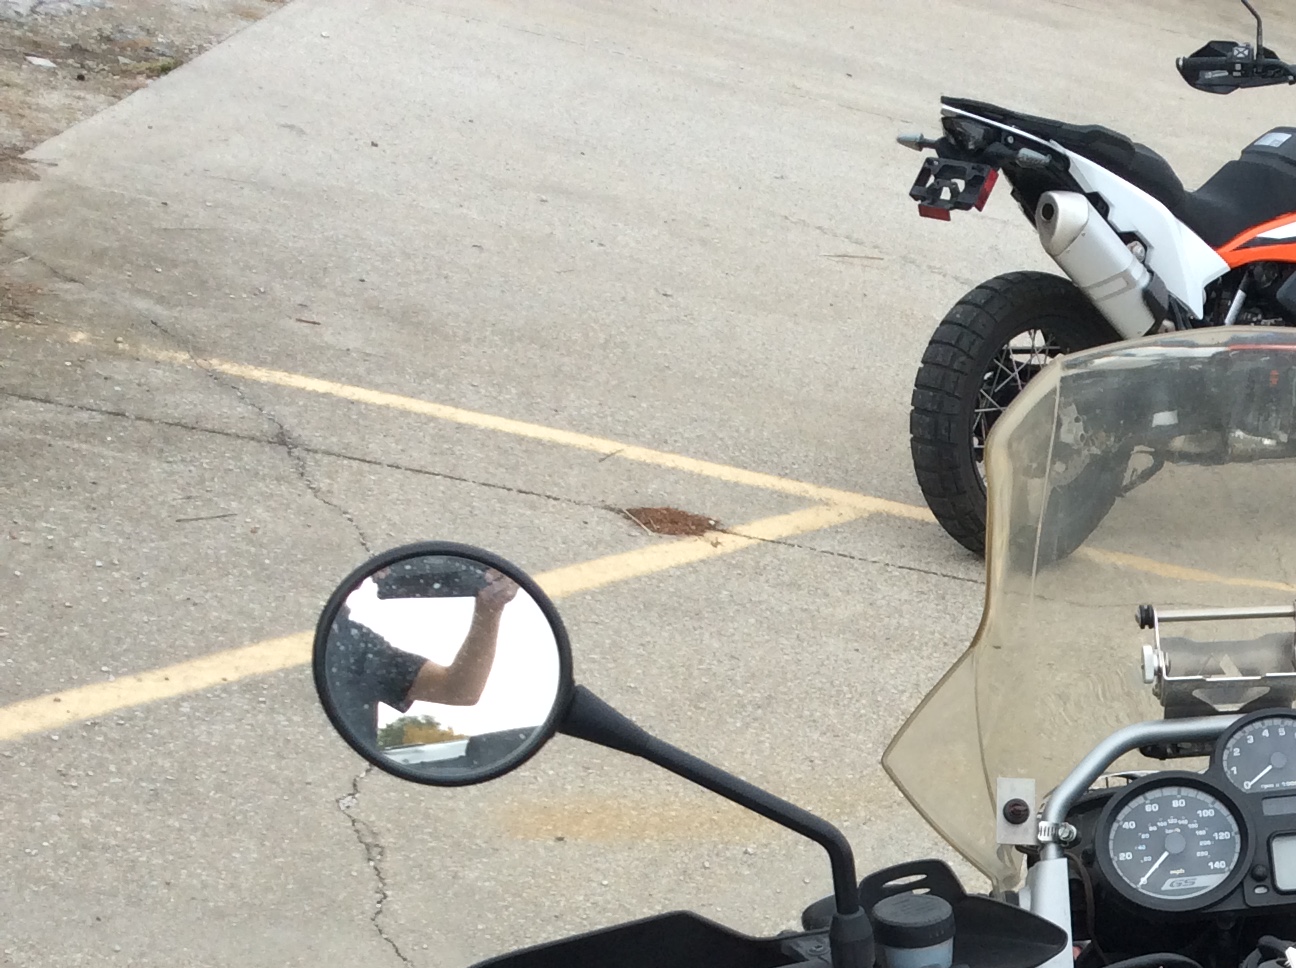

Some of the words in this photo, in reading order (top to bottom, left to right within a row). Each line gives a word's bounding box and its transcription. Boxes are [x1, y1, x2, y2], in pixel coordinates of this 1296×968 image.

[1262, 729, 1270, 737] 4
[1278, 727, 1286, 736] 5
[1246, 735, 1254, 744] 3
[1233, 747, 1241, 756] 2
[1231, 766, 1238, 775] 1
[1172, 799, 1186, 808] 80
[1196, 809, 1215, 818] 100
[1122, 821, 1136, 830] 40
[1212, 831, 1231, 840] 120
[1119, 852, 1133, 861] 20
[1208, 861, 1226, 870] 140
